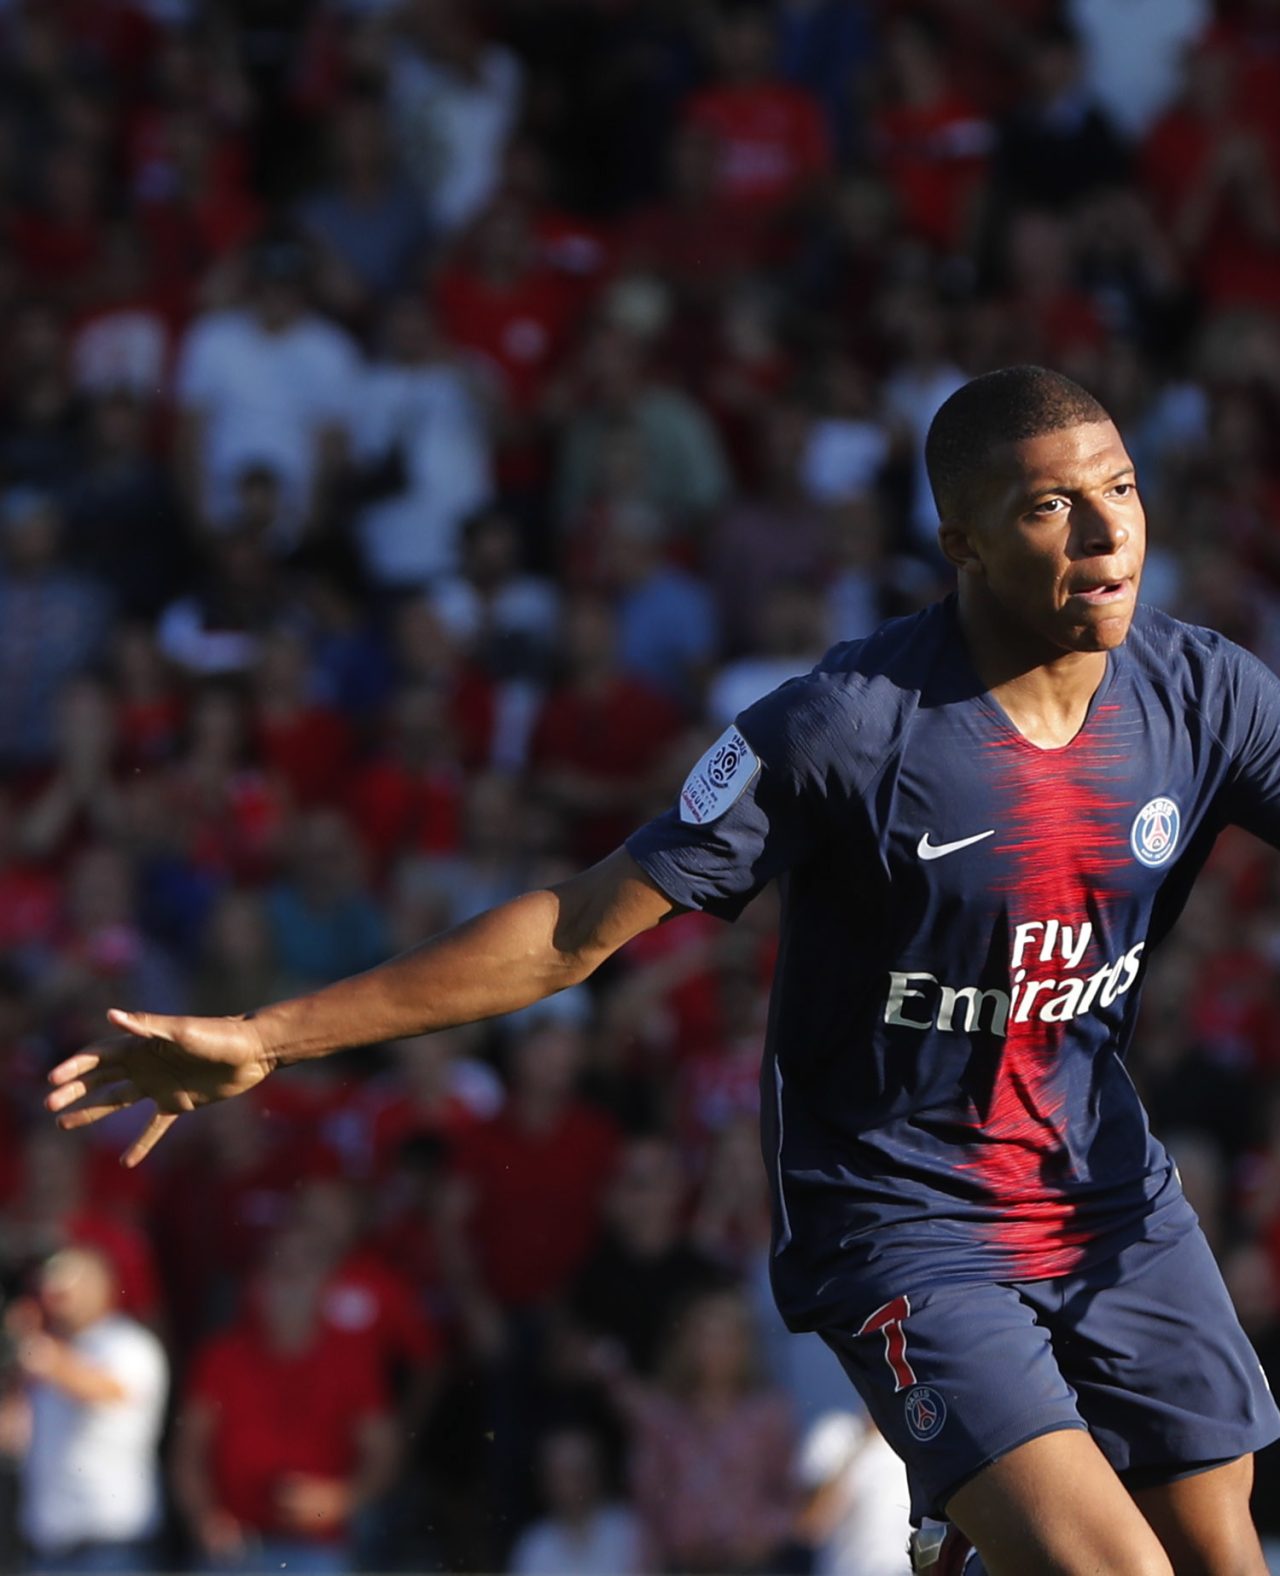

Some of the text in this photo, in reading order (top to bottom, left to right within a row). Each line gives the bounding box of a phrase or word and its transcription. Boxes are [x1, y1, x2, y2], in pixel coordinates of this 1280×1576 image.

[1142, 801, 1173, 820] PARIS
[1011, 919, 1092, 969] Fly
[884, 941, 1145, 1038] Emirates
[852, 1294, 917, 1393] 7
